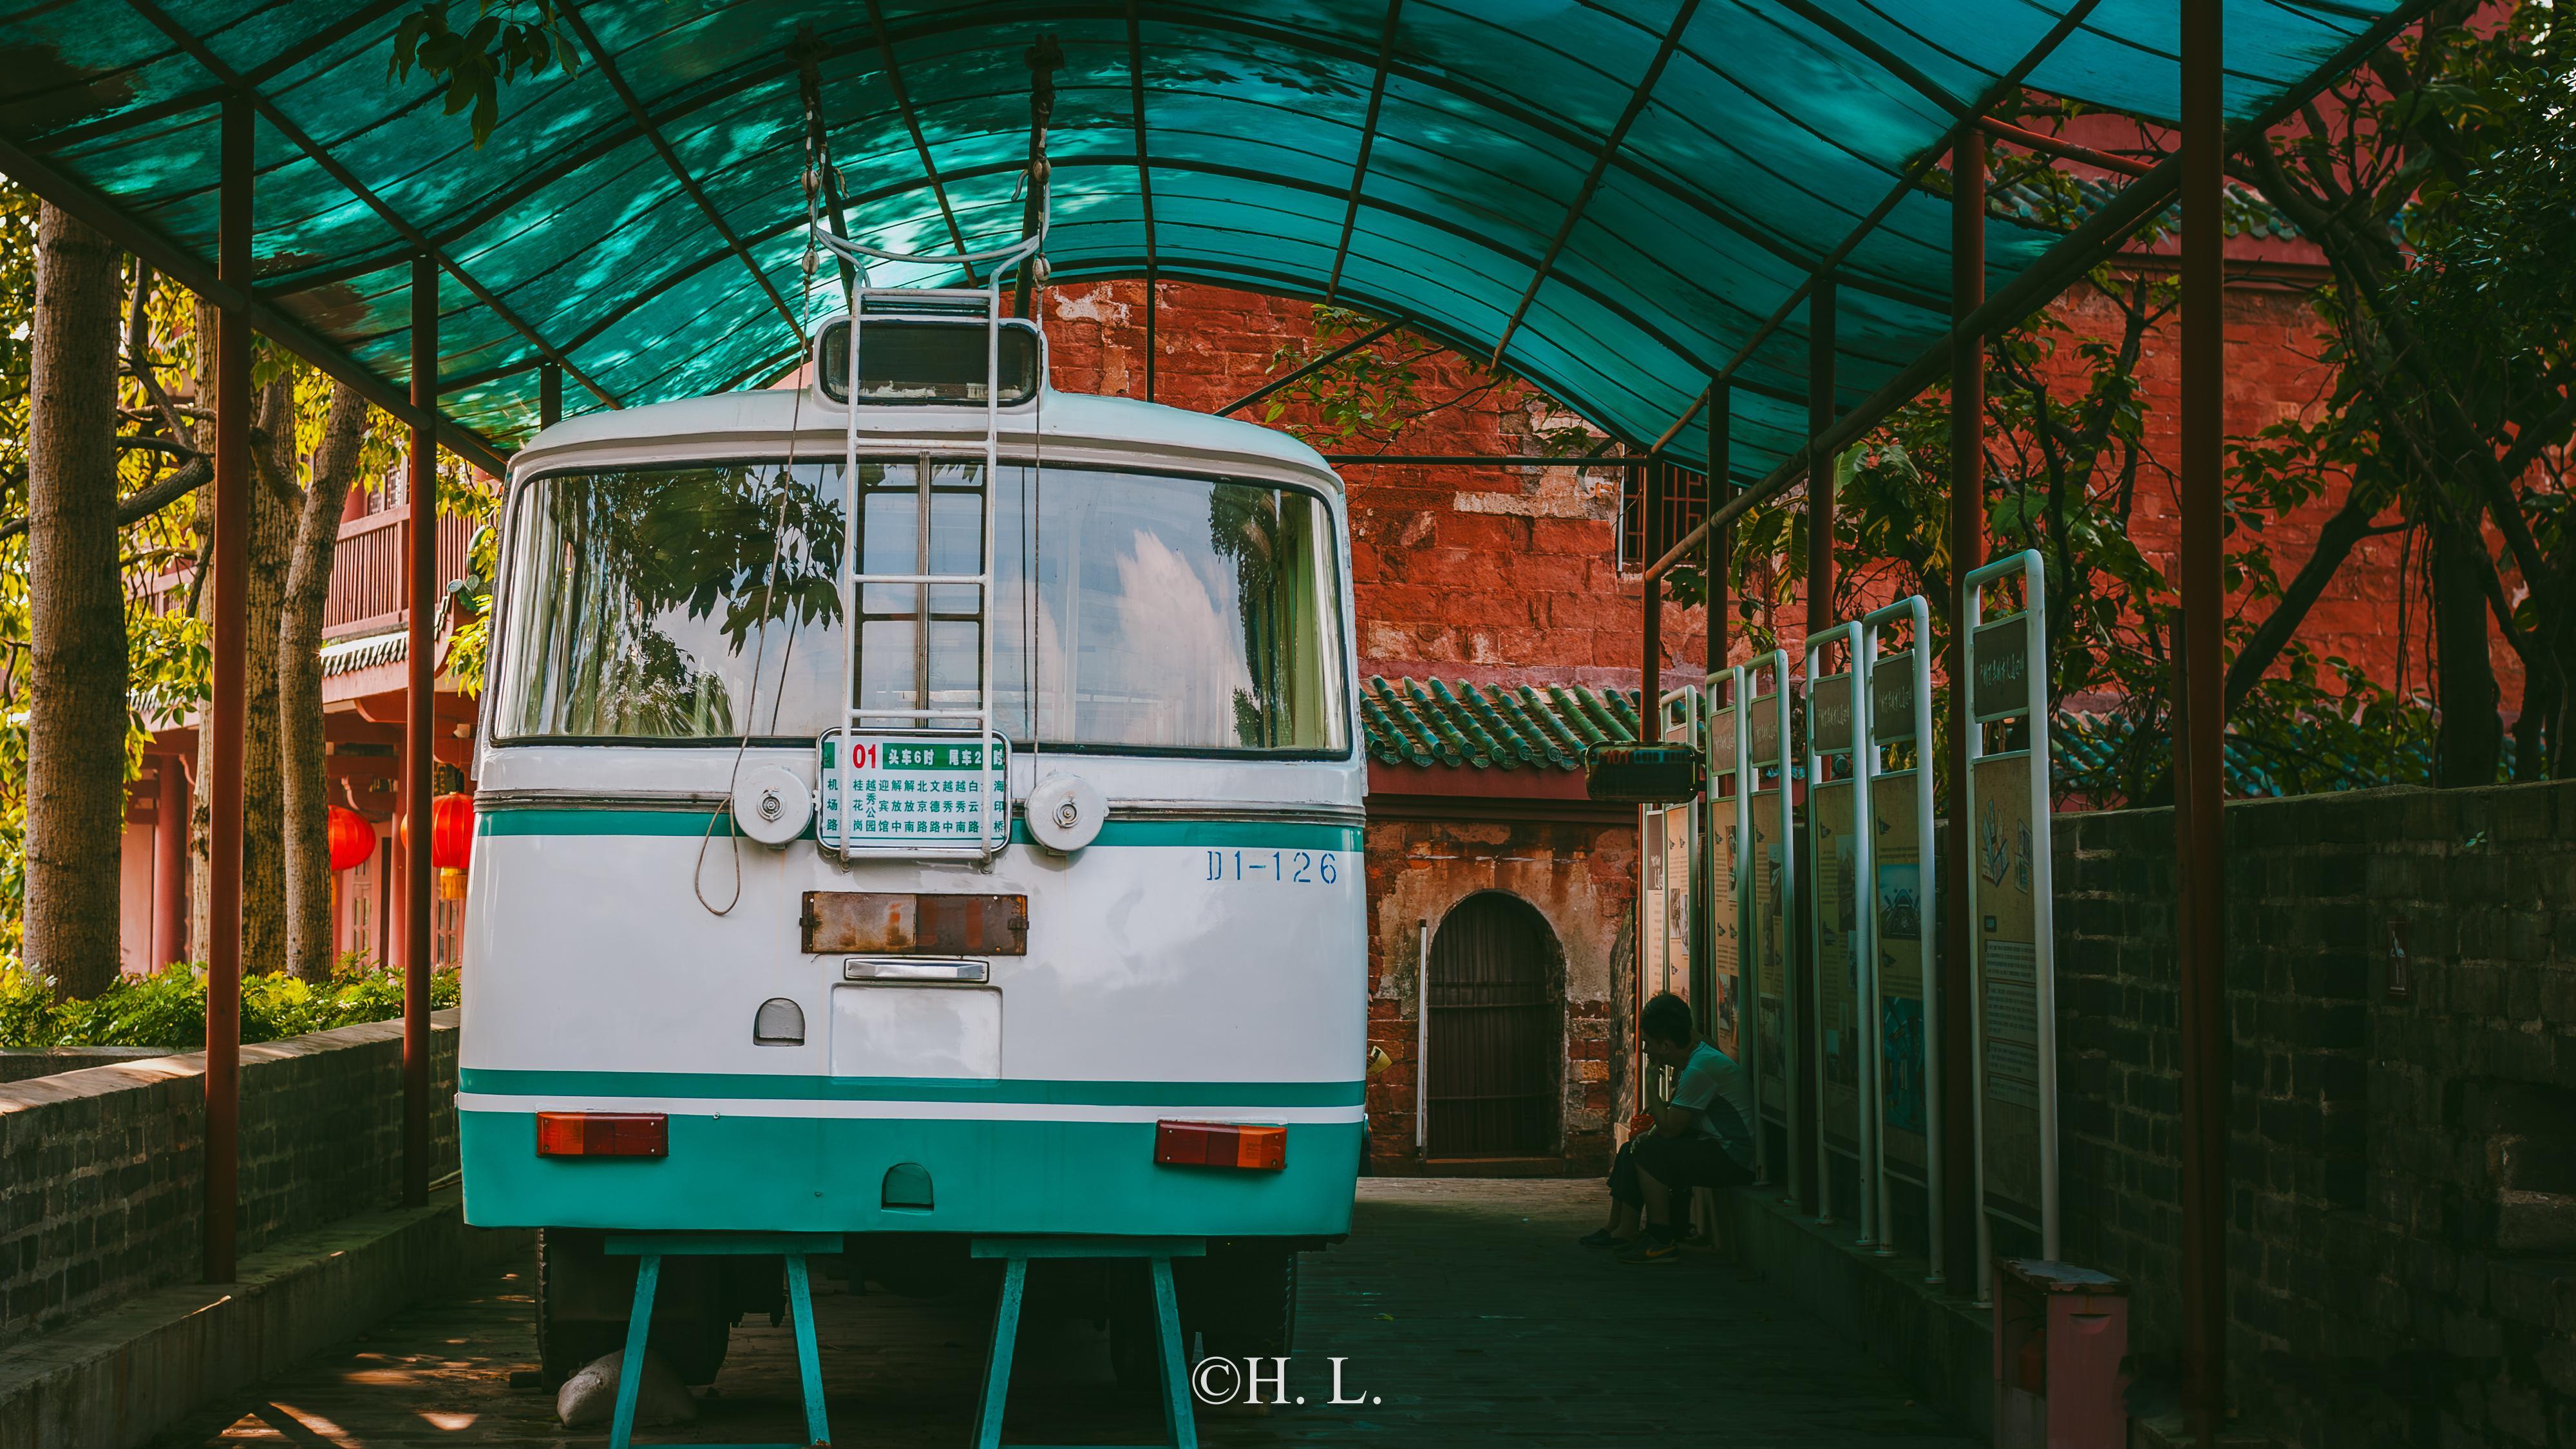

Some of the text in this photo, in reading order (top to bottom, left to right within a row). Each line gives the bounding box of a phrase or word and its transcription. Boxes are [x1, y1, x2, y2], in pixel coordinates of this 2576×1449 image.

[841, 744, 876, 769] 01
[889, 748, 1003, 766] 头车6时 尾车2时
[827, 779, 838, 831] 机场路
[853, 779, 863, 831] 桂花岗
[866, 779, 876, 832] 越秀公园
[878, 780, 889, 833] 迎宾馆
[891, 780, 902, 833] 解放中
[904, 780, 914, 833] 解放南
[917, 780, 927, 833] 北京路
[930, 780, 940, 833] 文德路
[943, 780, 953, 833] 越秀中
[955, 780, 966, 833] 越秀南
[968, 780, 979, 833] 白云路
[1206, 850, 1337, 884] D1-126
